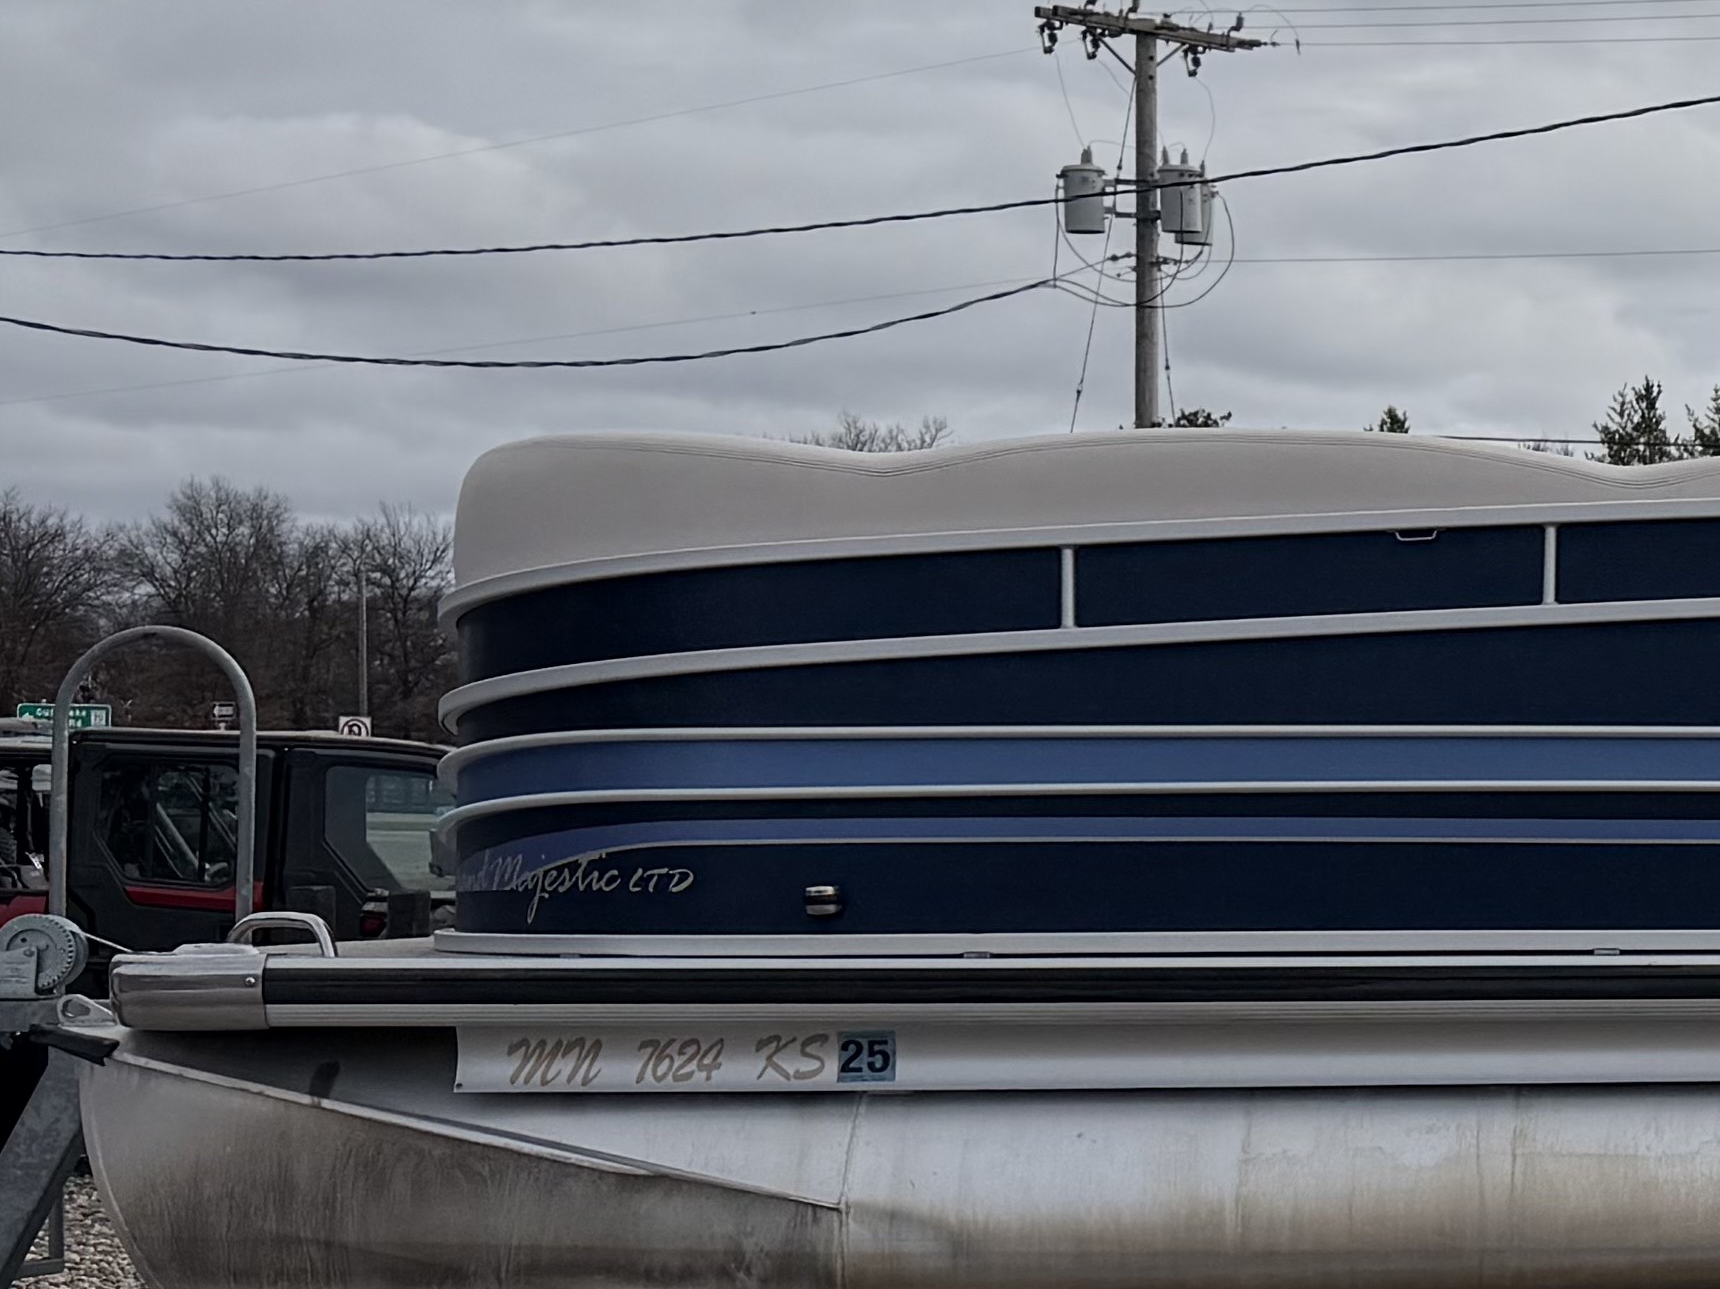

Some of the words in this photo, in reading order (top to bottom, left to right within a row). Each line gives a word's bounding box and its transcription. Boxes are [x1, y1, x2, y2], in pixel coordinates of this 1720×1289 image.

[490, 852, 621, 925] Majestic
[629, 867, 695, 894] LTD
[506, 1036, 602, 1087] MN
[635, 1036, 725, 1085] 7624
[754, 1032, 830, 1082] KS
[840, 1038, 892, 1075] 25
